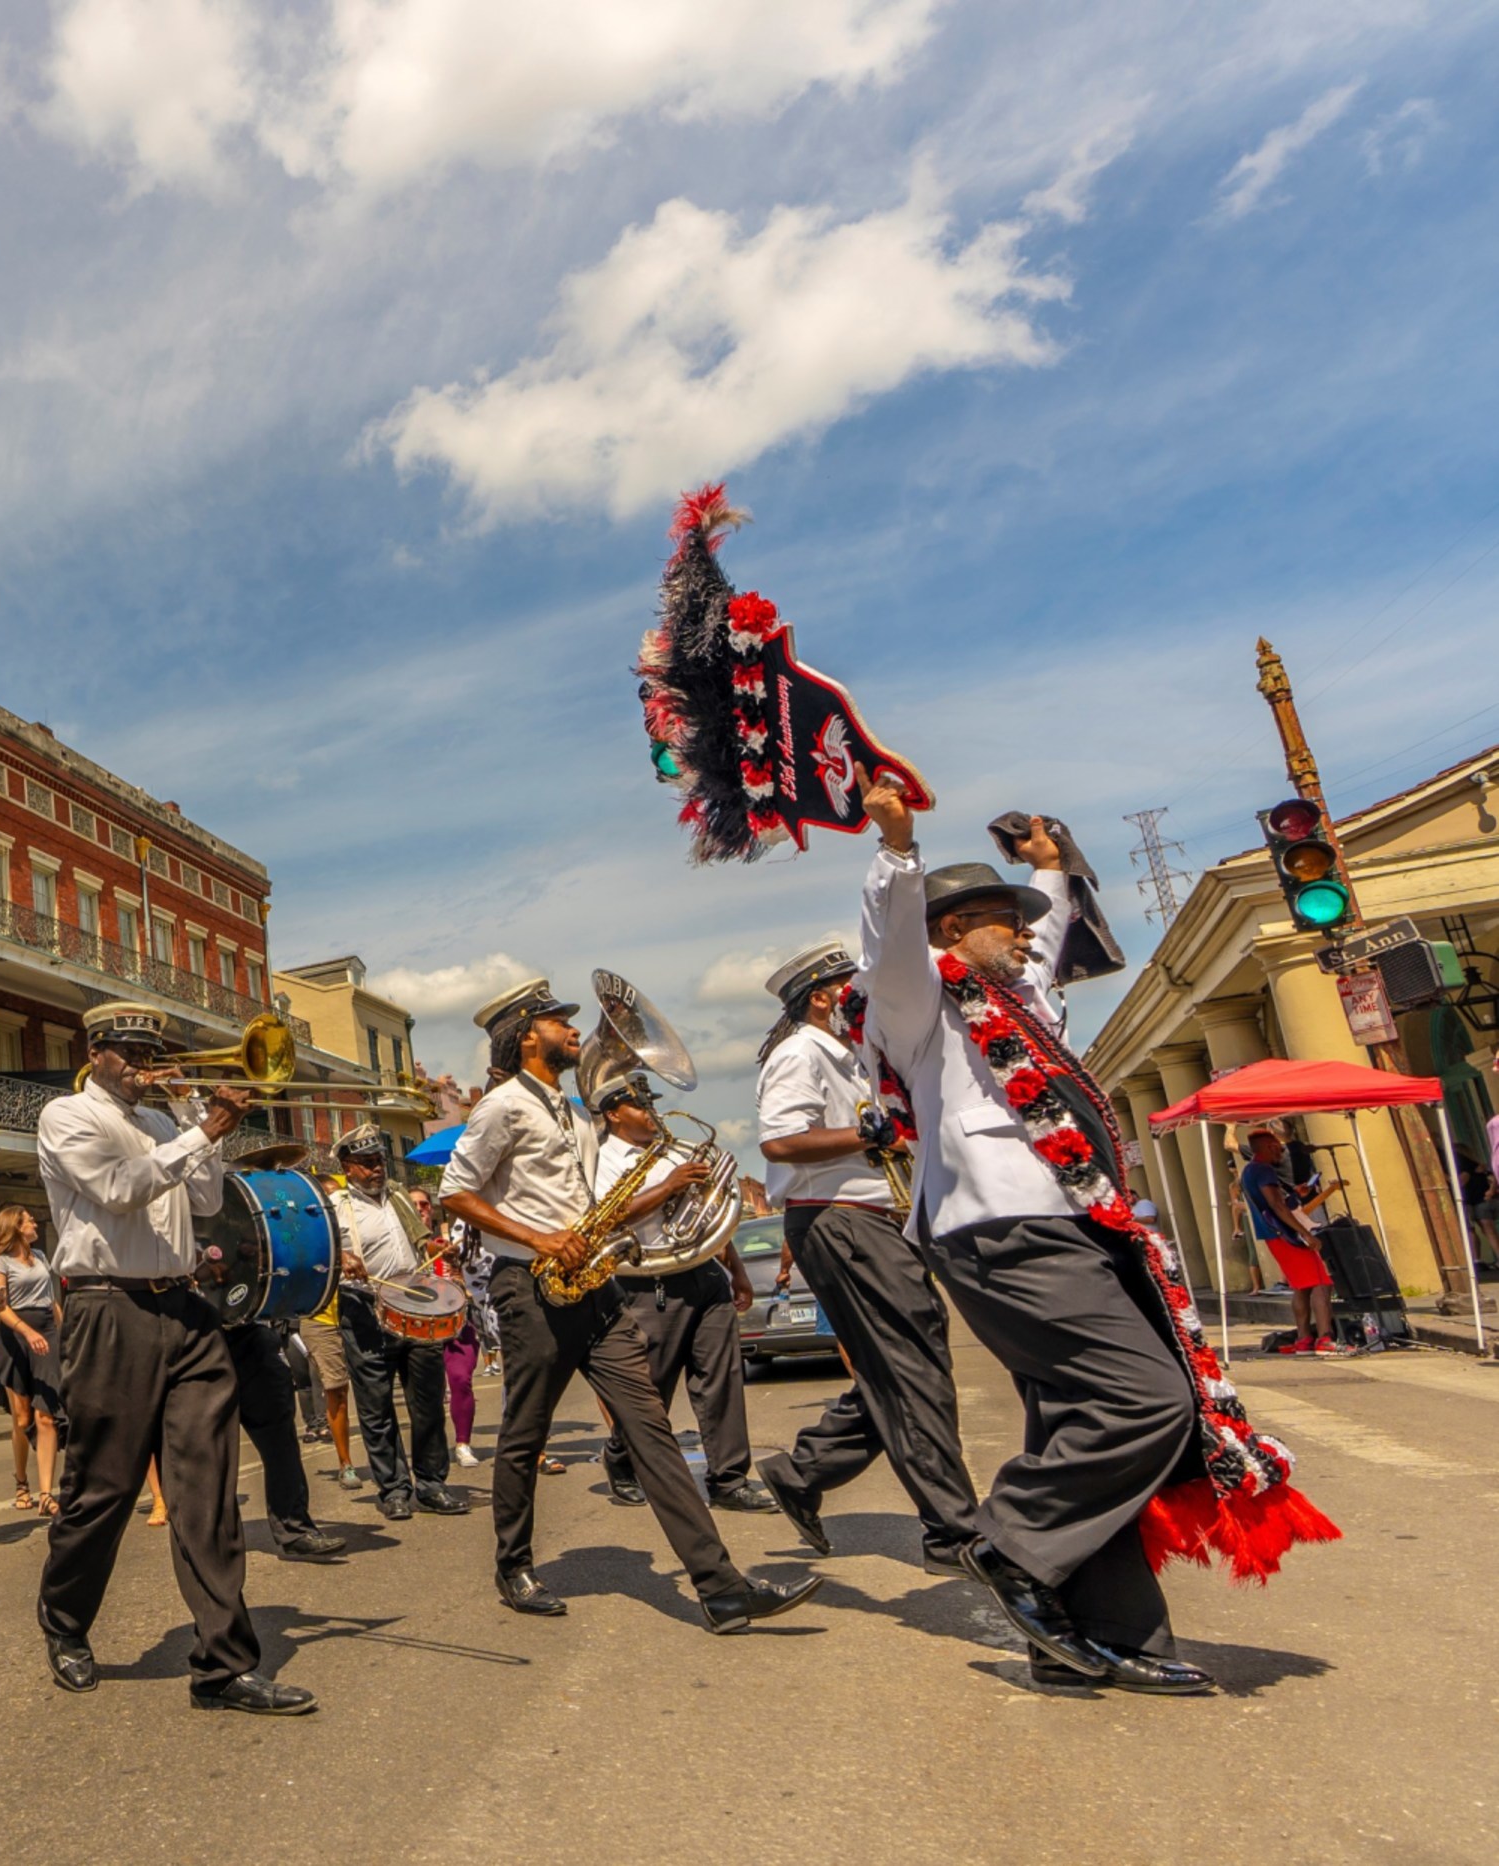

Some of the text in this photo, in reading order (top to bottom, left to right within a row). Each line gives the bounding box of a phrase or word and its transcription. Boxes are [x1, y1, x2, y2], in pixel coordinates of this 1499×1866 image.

[776, 673, 793, 765] Anniversary
[1328, 930, 1407, 965] St. Ann
[1351, 991, 1375, 1006] ANY
[1353, 1003, 1379, 1015] TIME
[125, 1016, 154, 1030] YPS
